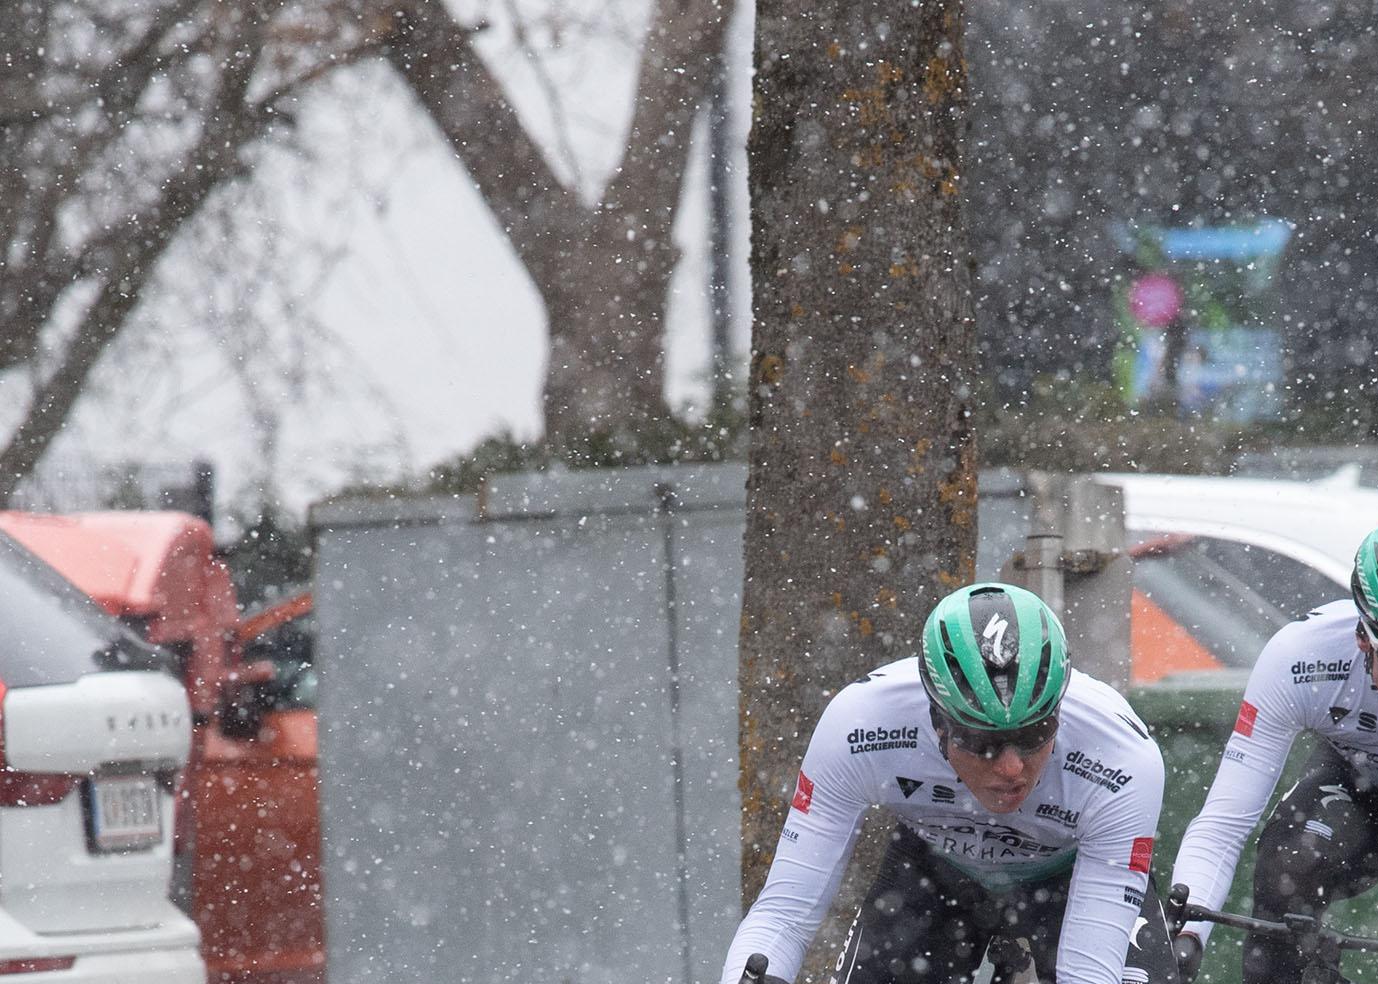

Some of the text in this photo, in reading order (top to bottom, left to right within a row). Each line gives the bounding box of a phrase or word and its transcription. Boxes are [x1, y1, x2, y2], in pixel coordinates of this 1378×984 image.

[1291, 660, 1352, 674] diebald
[846, 726, 918, 744] diebald
[1066, 750, 1133, 786] diebald
[1036, 803, 1080, 824] Röckl
